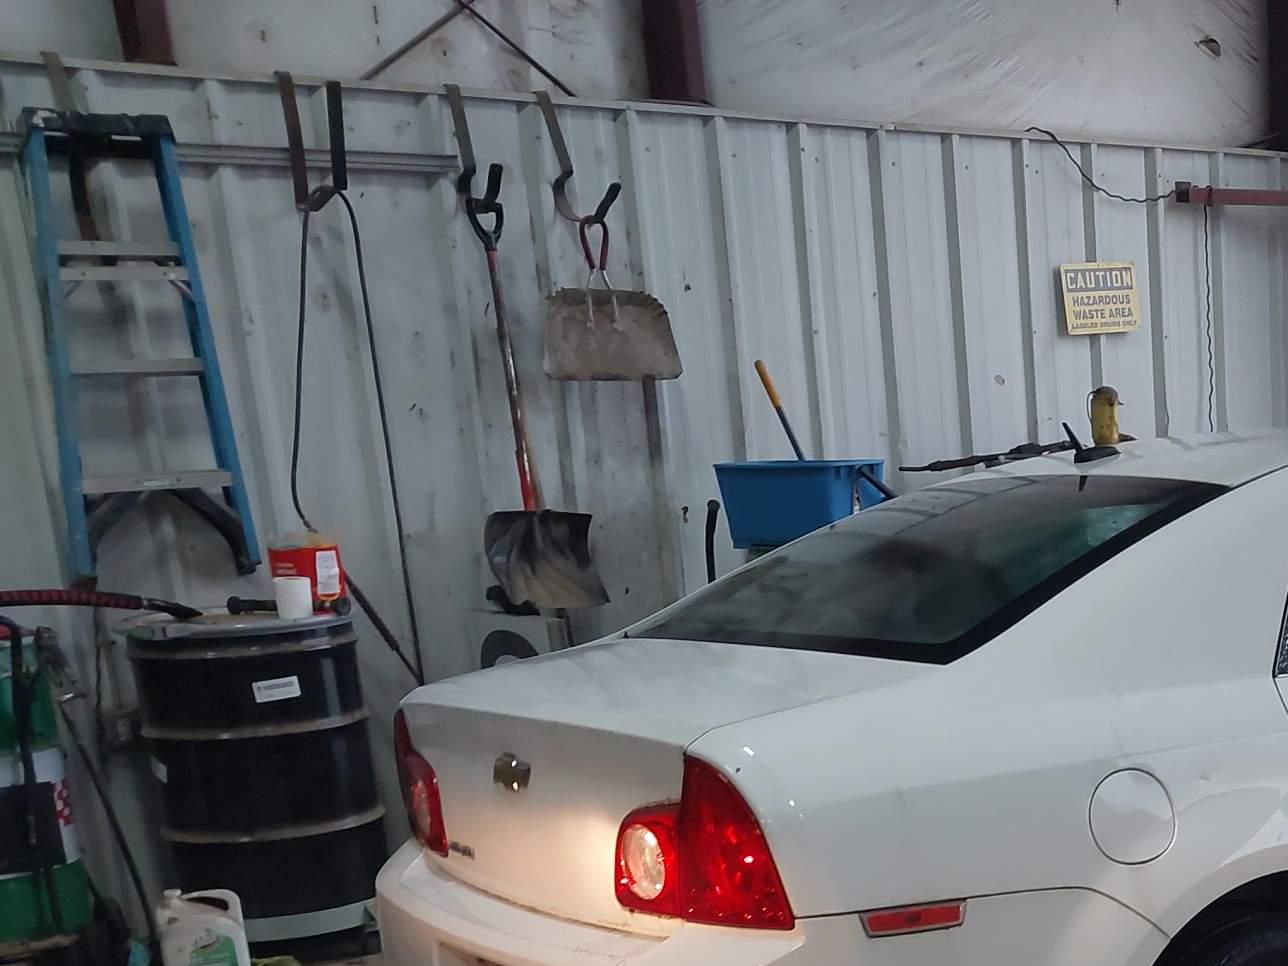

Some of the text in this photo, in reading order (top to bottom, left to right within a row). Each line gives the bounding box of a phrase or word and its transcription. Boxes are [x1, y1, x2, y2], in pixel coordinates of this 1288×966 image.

[1066, 270, 1132, 289] CAUTION
[1072, 294, 1131, 307] HAZARDOUS
[1073, 307, 1133, 320] WASTE AREA
[1071, 321, 1099, 329] LABELED
[1122, 319, 1137, 327] ONLY
